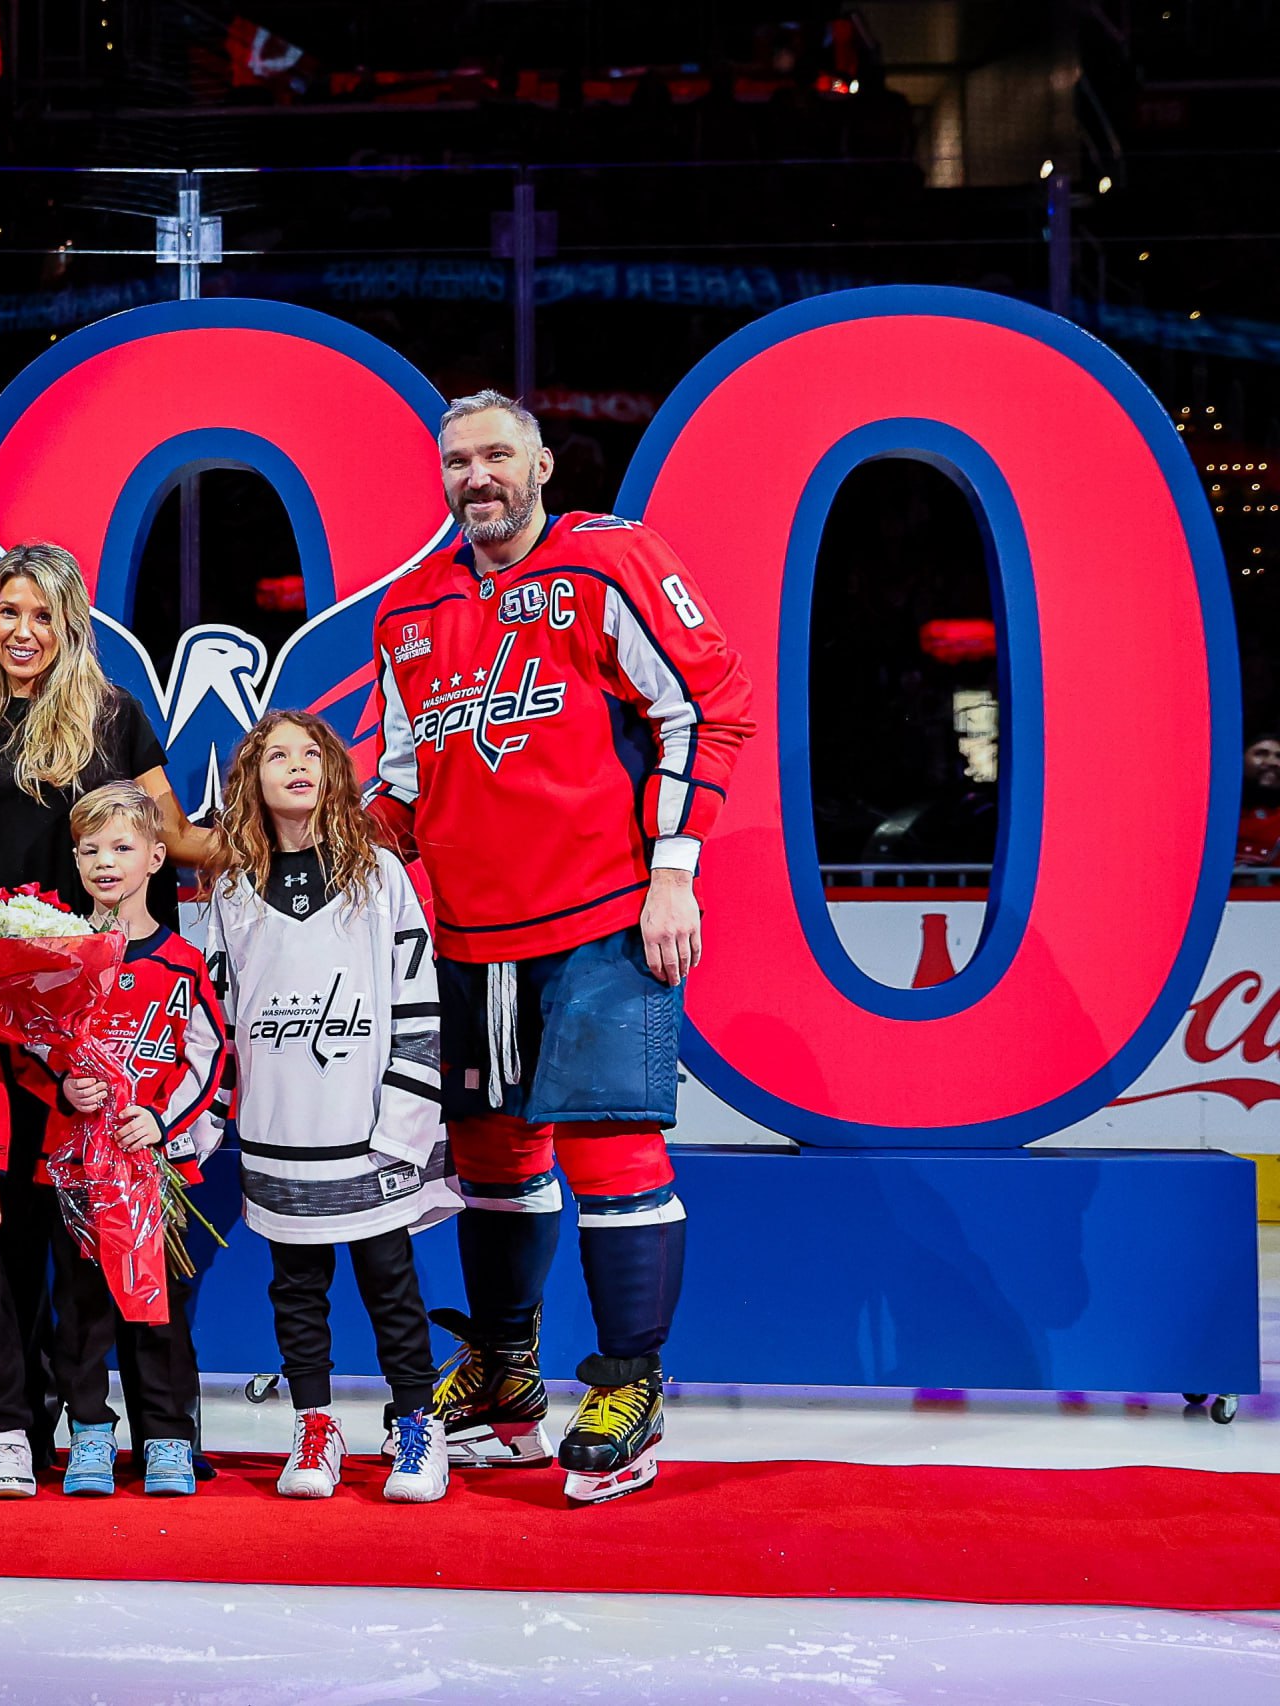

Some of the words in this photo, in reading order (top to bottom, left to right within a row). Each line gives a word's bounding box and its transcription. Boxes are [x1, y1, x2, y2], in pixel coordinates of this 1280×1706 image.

[500, 582, 547, 622] 50
[549, 578, 576, 630] C
[661, 573, 705, 629] 8
[394, 637, 431, 655] CAESARS
[395, 646, 432, 664] SPORTSBOOK
[413, 631, 567, 774] capitals
[422, 686, 483, 709] WASHINGTON
[394, 928, 428, 980] 7
[165, 976, 191, 1020] A
[250, 972, 372, 1069] capitals
[262, 1008, 320, 1017] WASHINGTON
